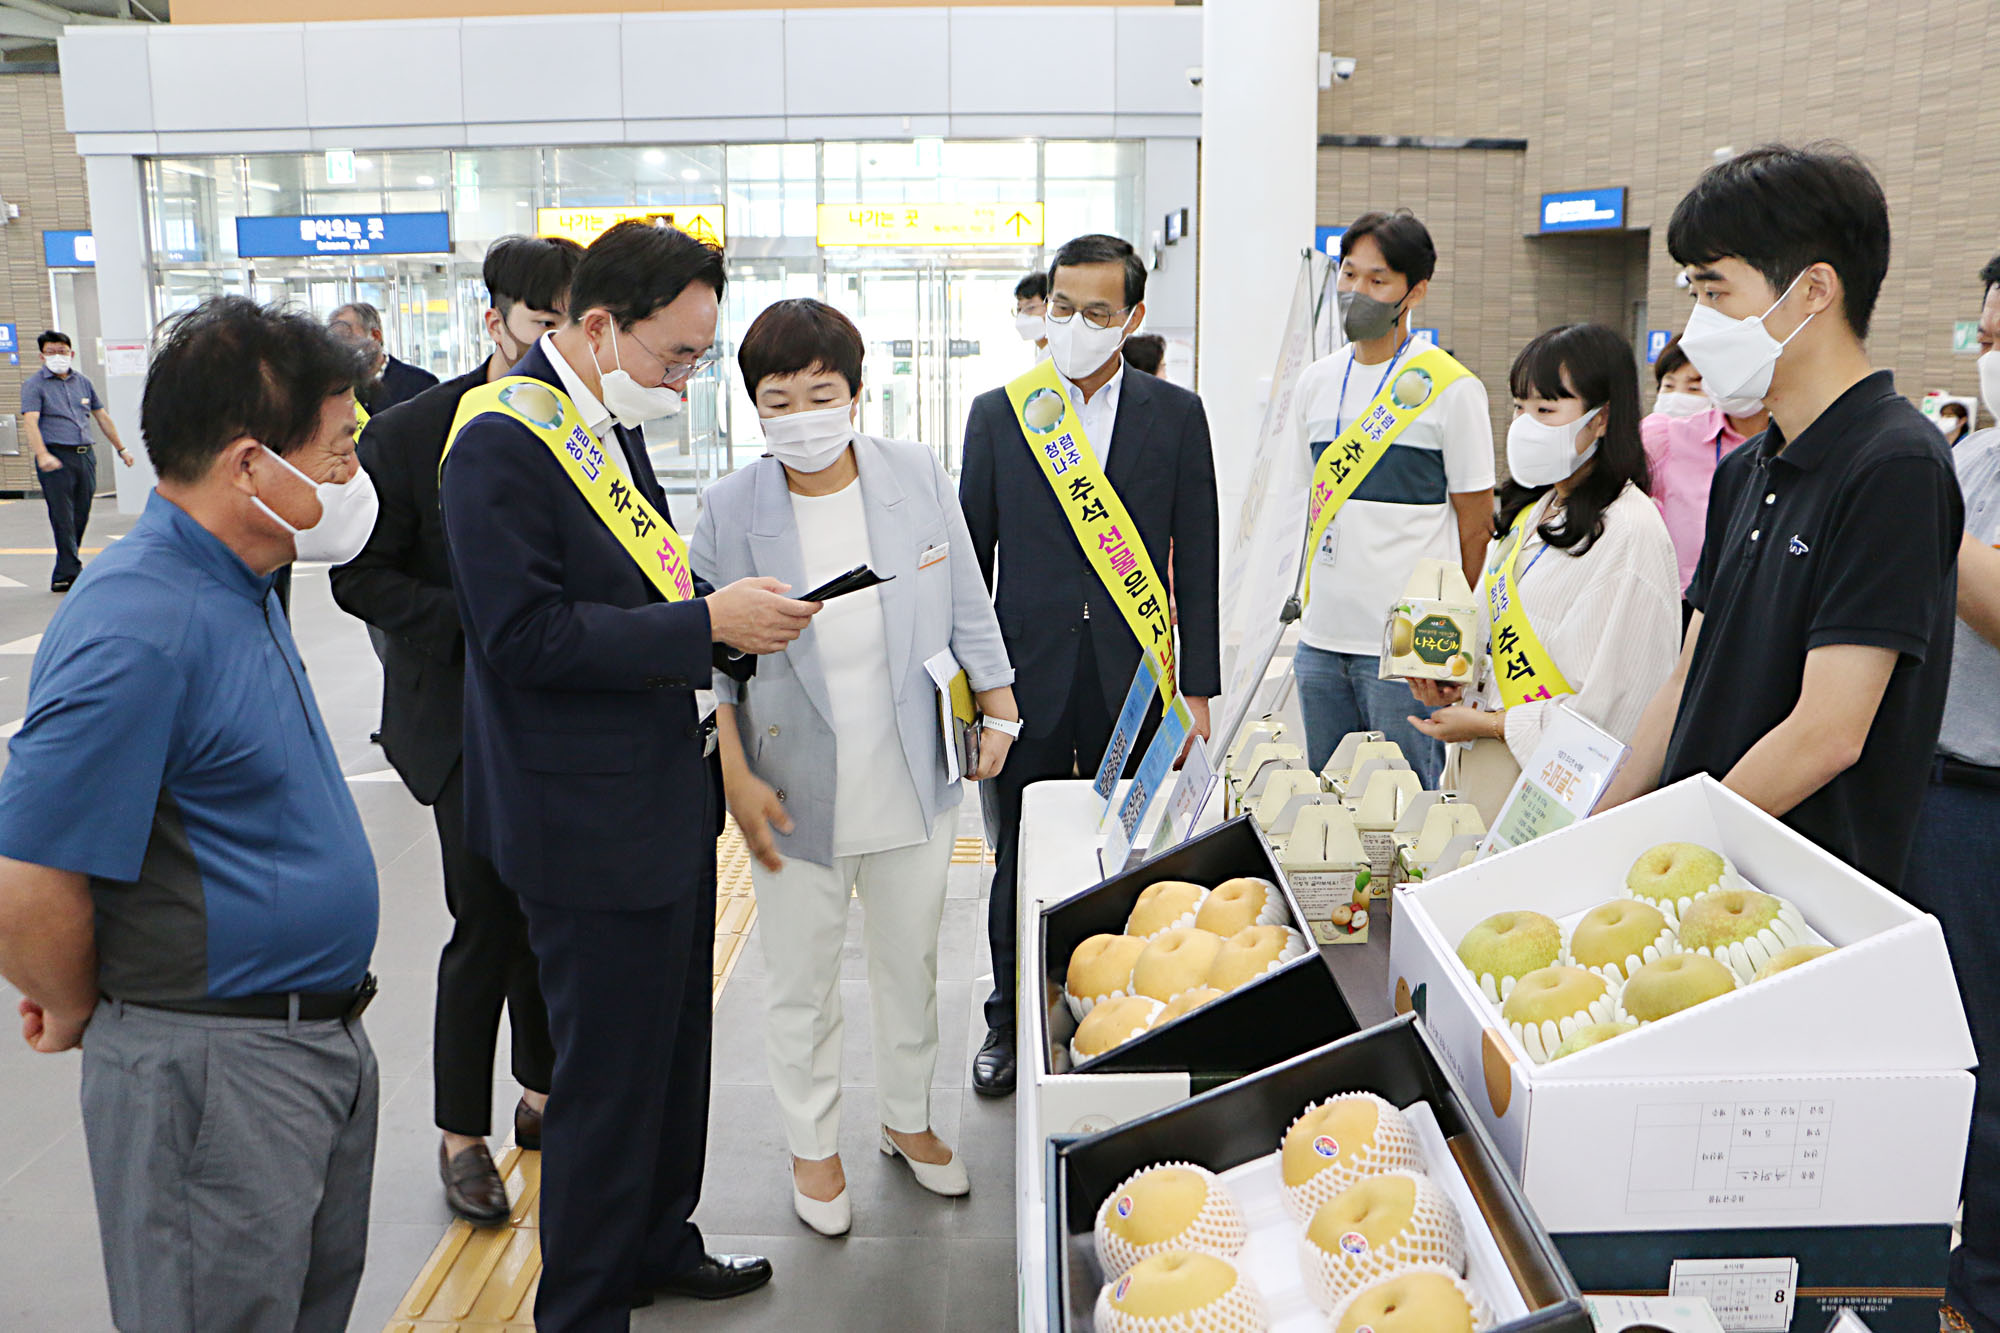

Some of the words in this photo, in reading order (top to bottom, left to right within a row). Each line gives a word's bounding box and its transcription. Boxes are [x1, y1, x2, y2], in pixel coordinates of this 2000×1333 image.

[559, 215, 604, 231] 나가는
[849, 209, 895, 228] 나가는
[905, 209, 919, 228] 곳
[1360, 416, 1384, 441] 나주
[1373, 405, 1397, 430] 청렴
[566, 424, 591, 461] 청렴
[1044, 433, 1075, 459] 청렴
[581, 444, 605, 482] 나주
[1052, 449, 1082, 475] 나주
[1330, 439, 1365, 484] 추석
[608, 478, 657, 538] 추석
[1310, 480, 1334, 537] 선물
[1068, 475, 1110, 523] 추석
[1137, 594, 1168, 644] 역시
[1491, 592, 1509, 622] 나주
[1498, 624, 1536, 681] 추석
[1774, 1289, 1785, 1304] 8
